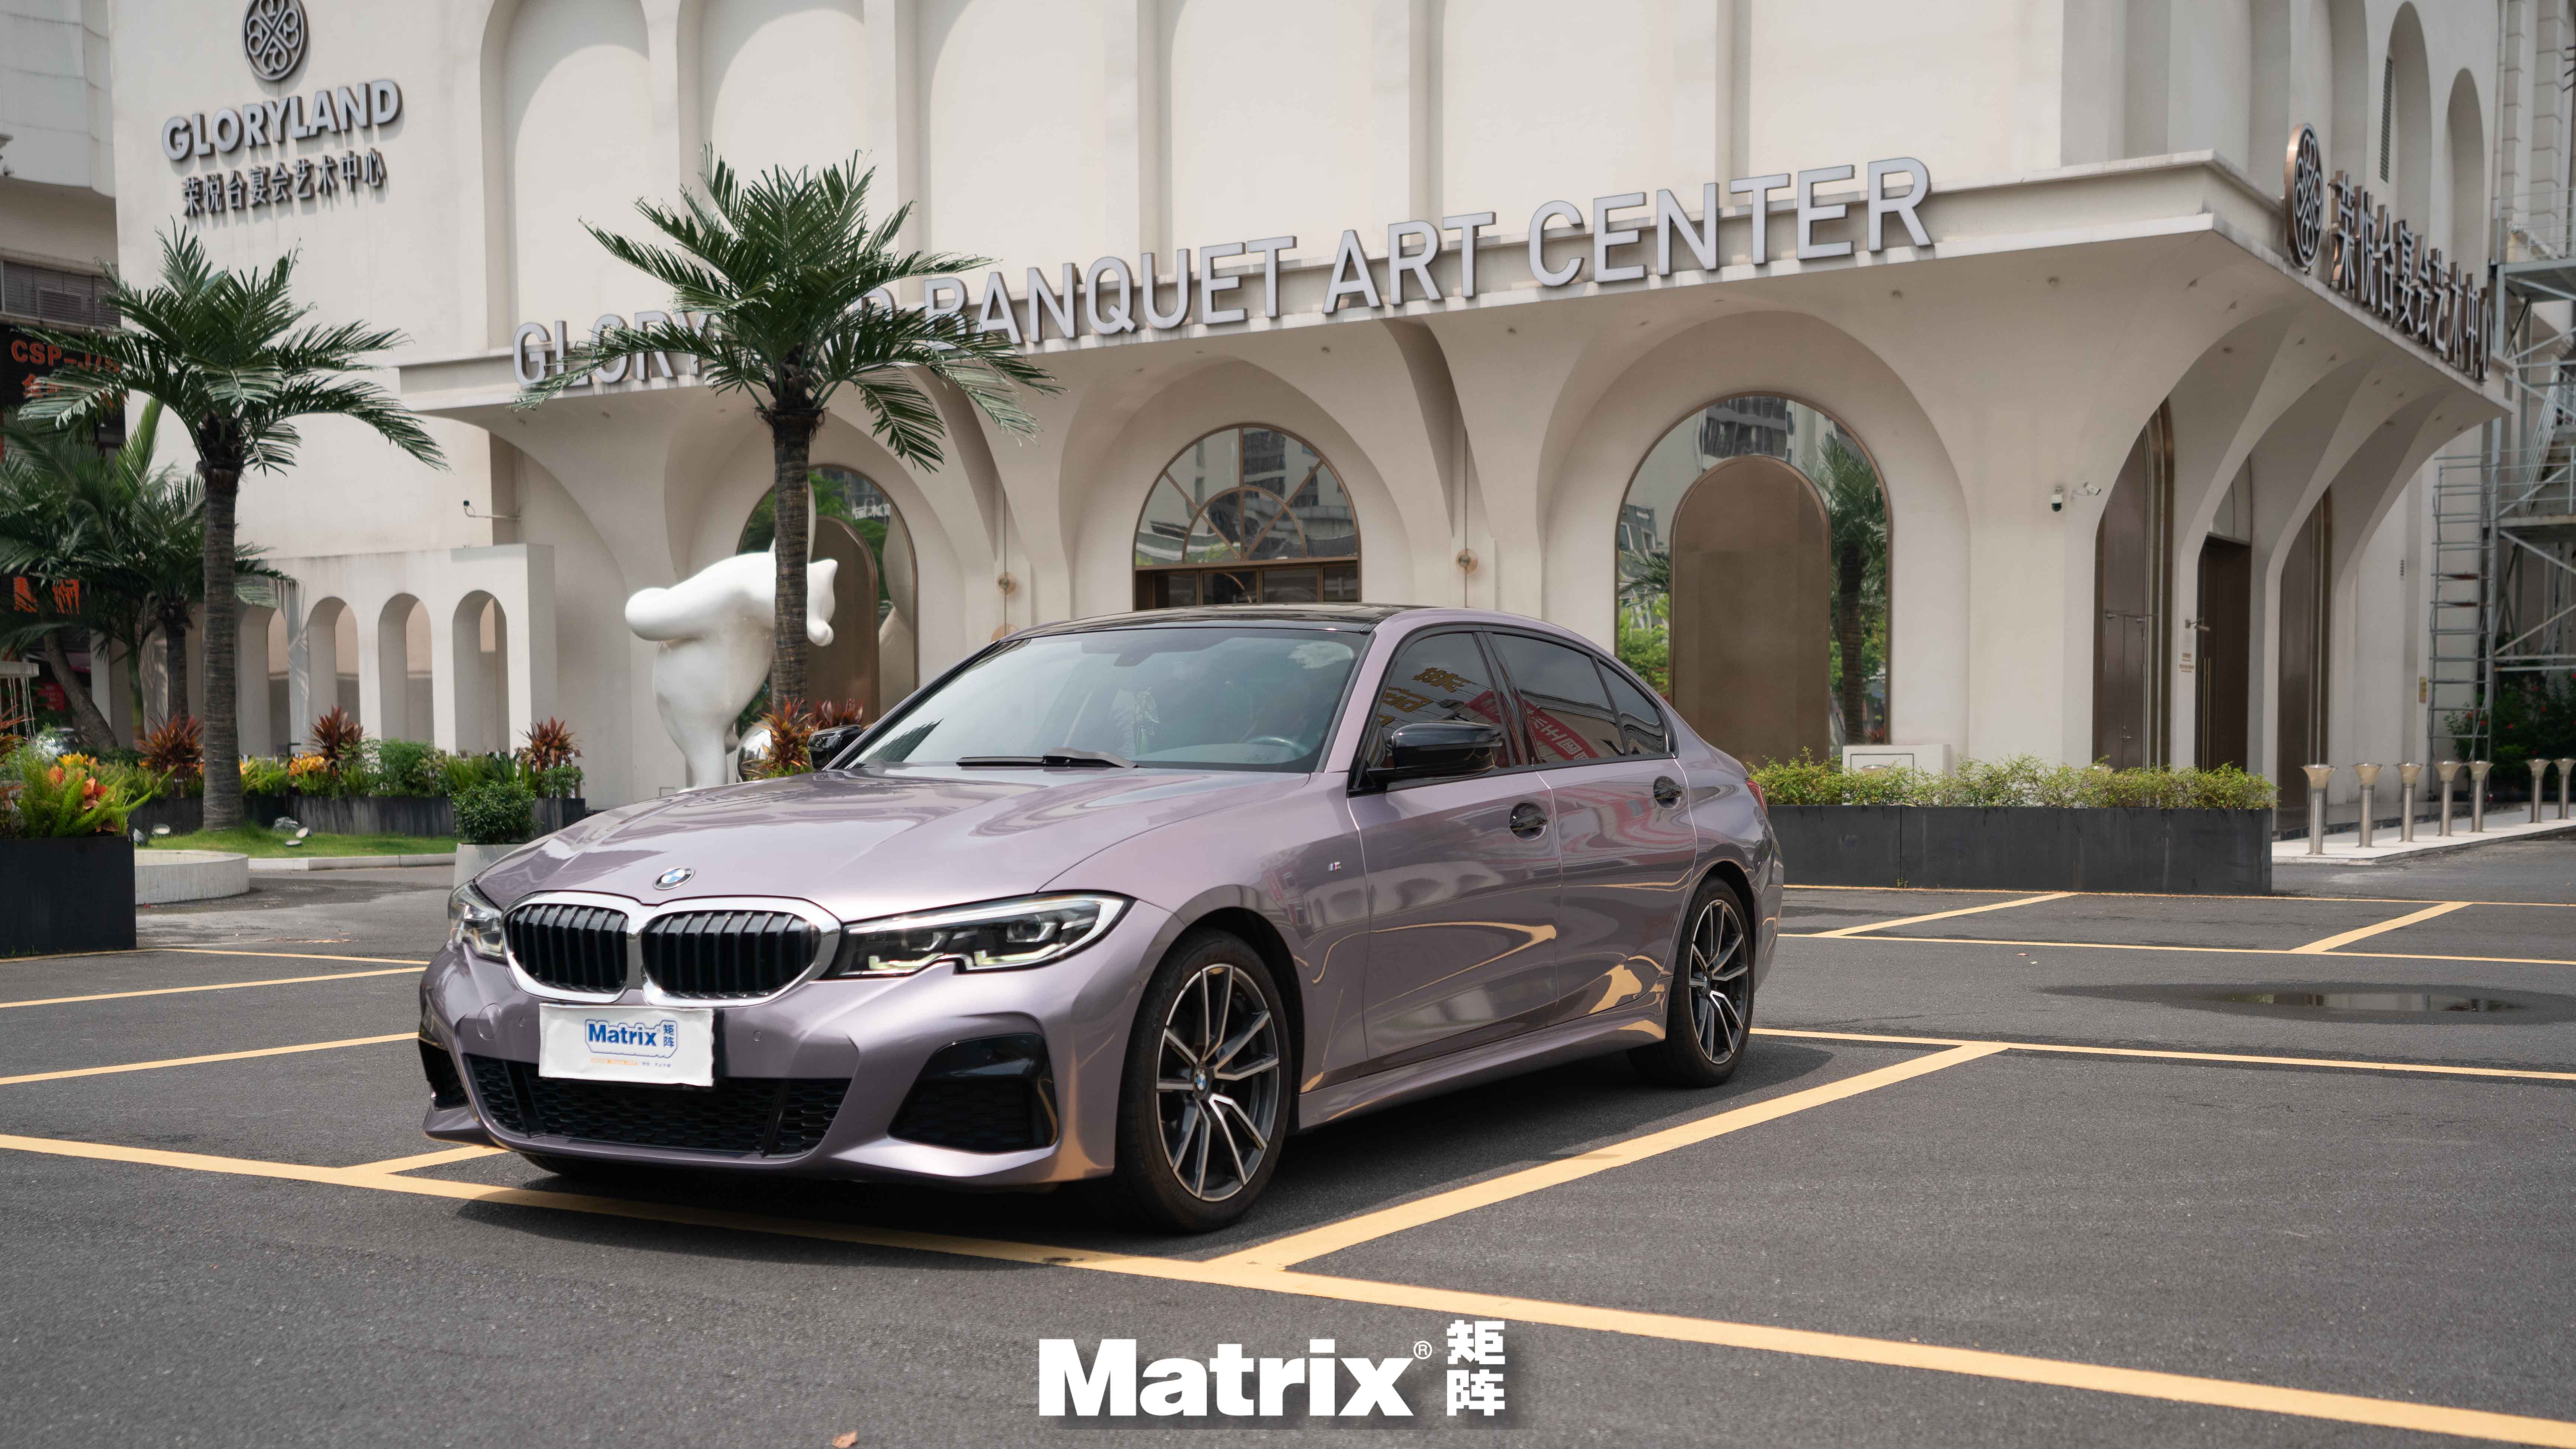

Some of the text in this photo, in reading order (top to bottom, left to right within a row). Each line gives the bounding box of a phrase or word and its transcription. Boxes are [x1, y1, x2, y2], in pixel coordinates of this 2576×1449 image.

[162, 79, 403, 161] GLORYLAND
[182, 148, 387, 216] 荣悦台宴会艺术中心
[924, 236, 1297, 351] BANQUET
[1322, 211, 1496, 315] ART
[1528, 157, 1934, 287] CENTER
[589, 1023, 657, 1046] Matrix
[663, 1024, 675, 1048] 矩阵
